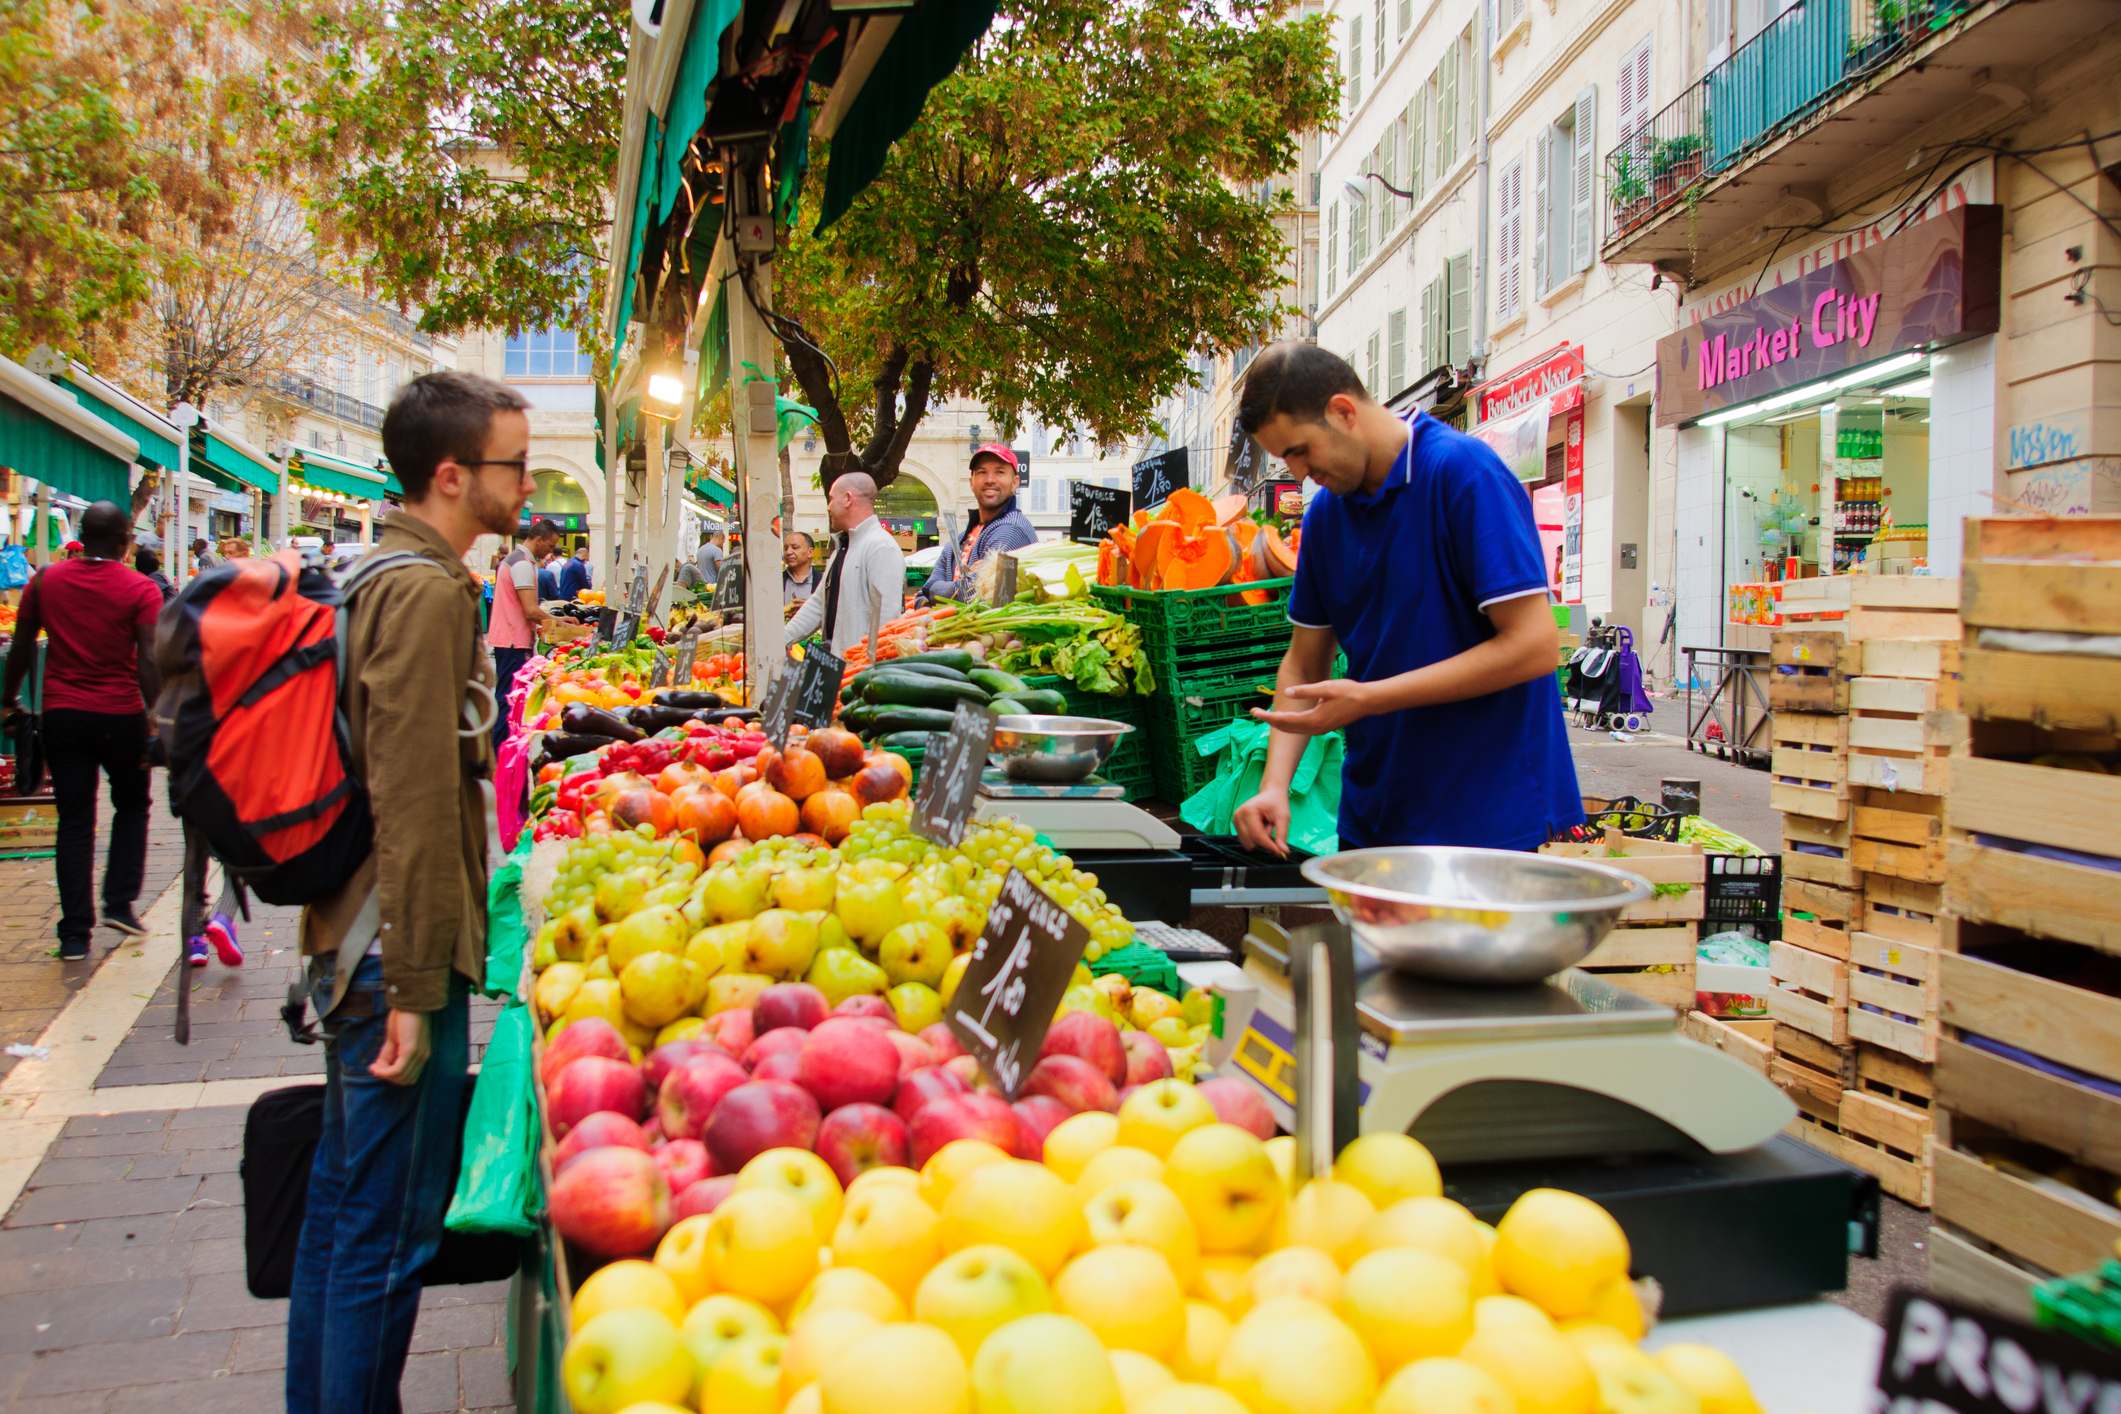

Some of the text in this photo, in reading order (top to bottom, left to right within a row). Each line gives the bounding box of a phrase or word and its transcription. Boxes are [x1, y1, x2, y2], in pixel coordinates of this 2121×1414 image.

[1698, 287, 1881, 391] Market City
[1487, 379, 1539, 420] Boucherie
[1539, 364, 1573, 396] Noor
[1002, 867, 1069, 941] PROVENCE
